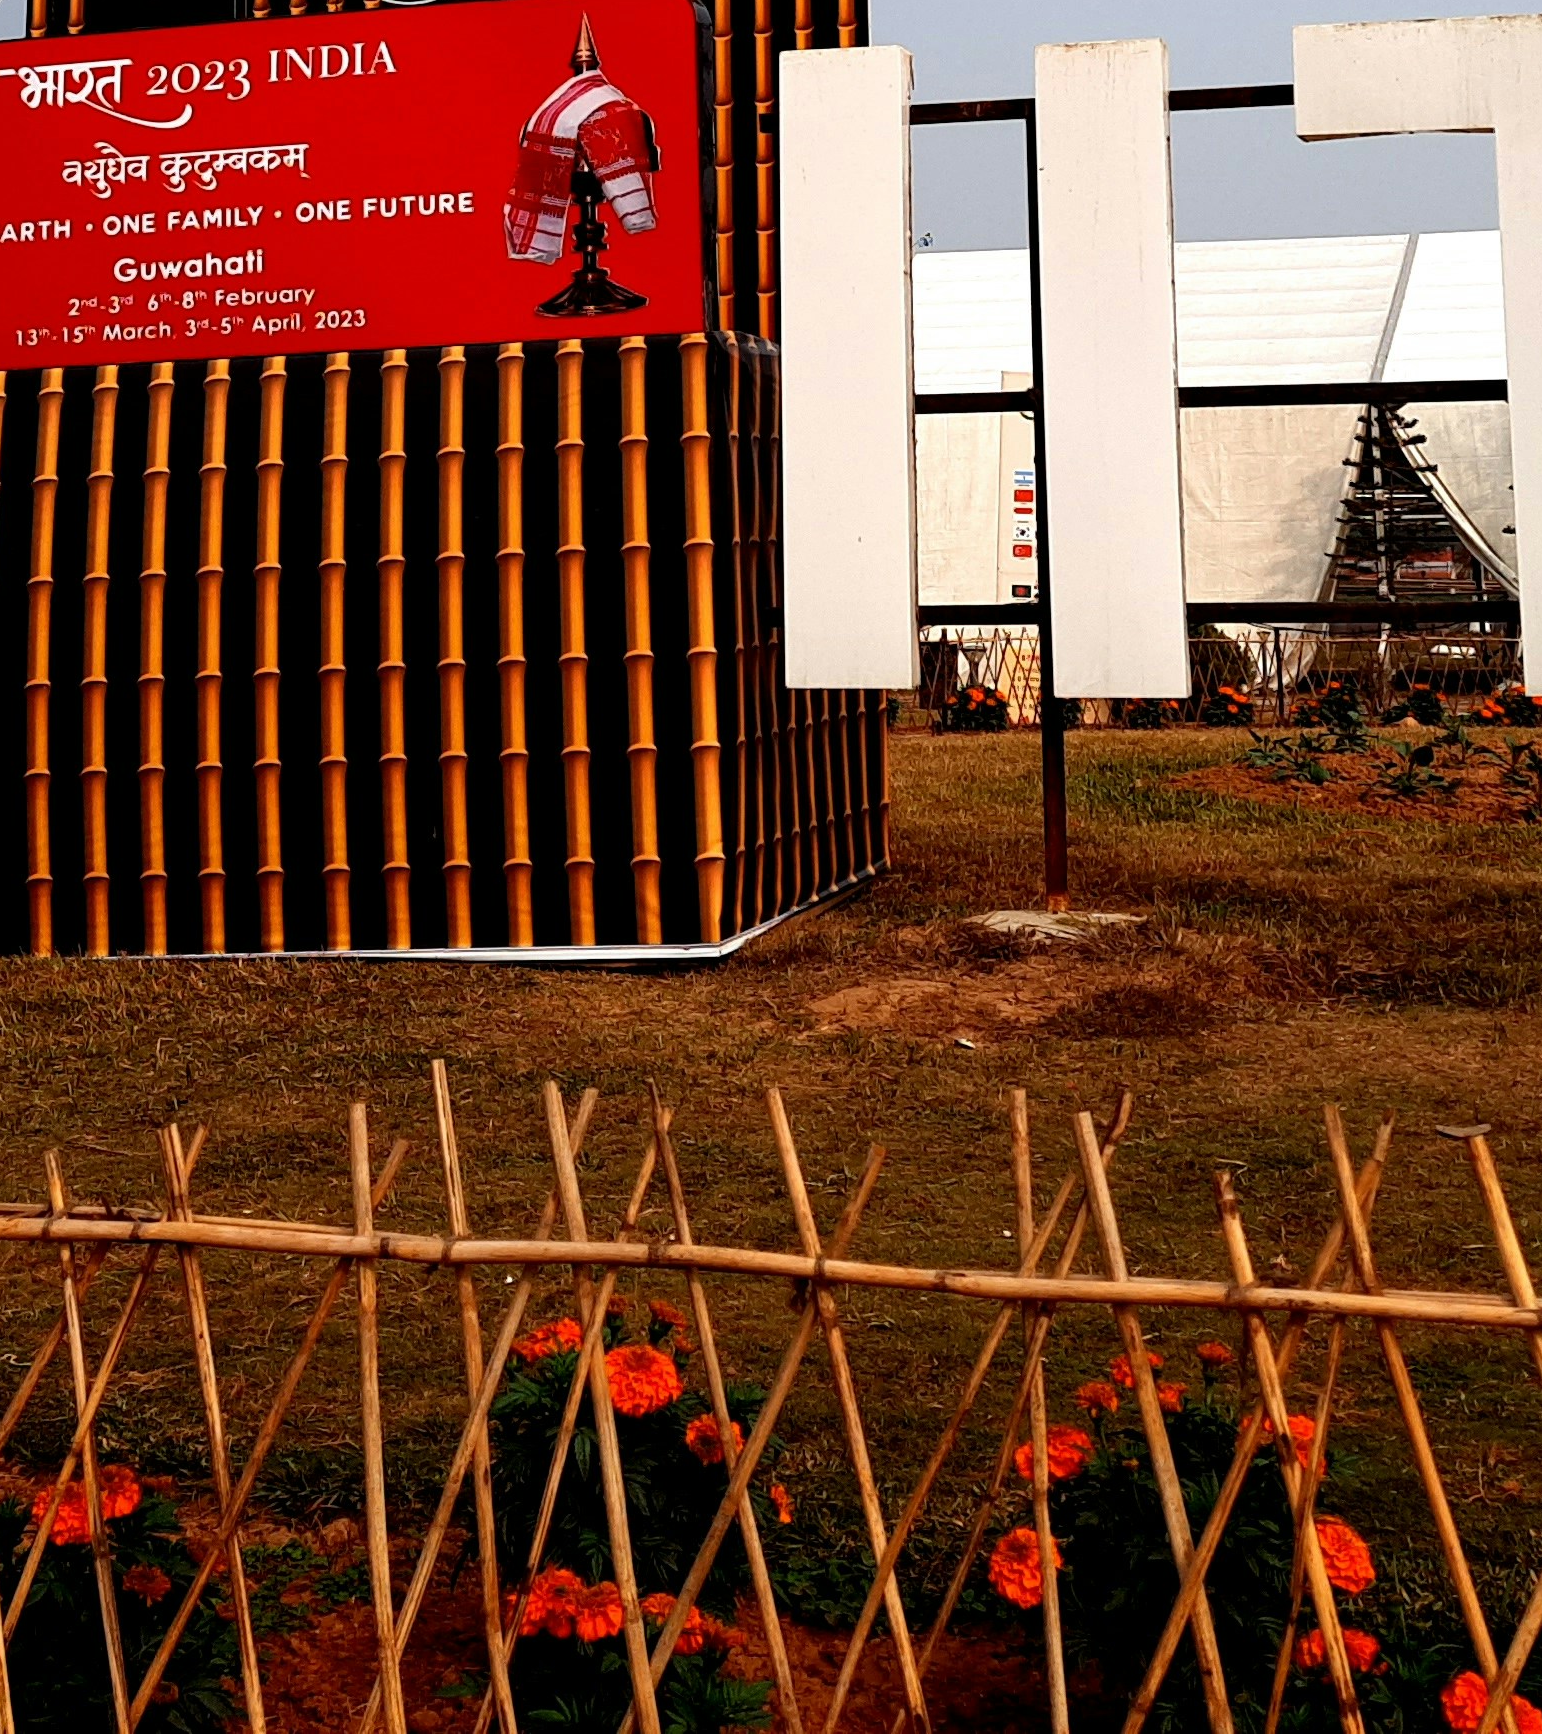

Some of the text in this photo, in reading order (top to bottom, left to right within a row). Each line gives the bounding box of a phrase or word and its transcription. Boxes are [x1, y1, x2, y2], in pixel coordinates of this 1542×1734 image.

[145, 58, 251, 101] 2023
[267, 40, 397, 83] INDIA
[102, 212, 157, 236] ONE
[167, 206, 263, 231] FAMILY
[295, 199, 352, 223] ONE
[362, 192, 475, 219] FUTURE
[113, 249, 263, 282] Guwahati
[214, 288, 316, 307] February
[252, 312, 306, 336] April,
[314, 309, 366, 329] 2023
